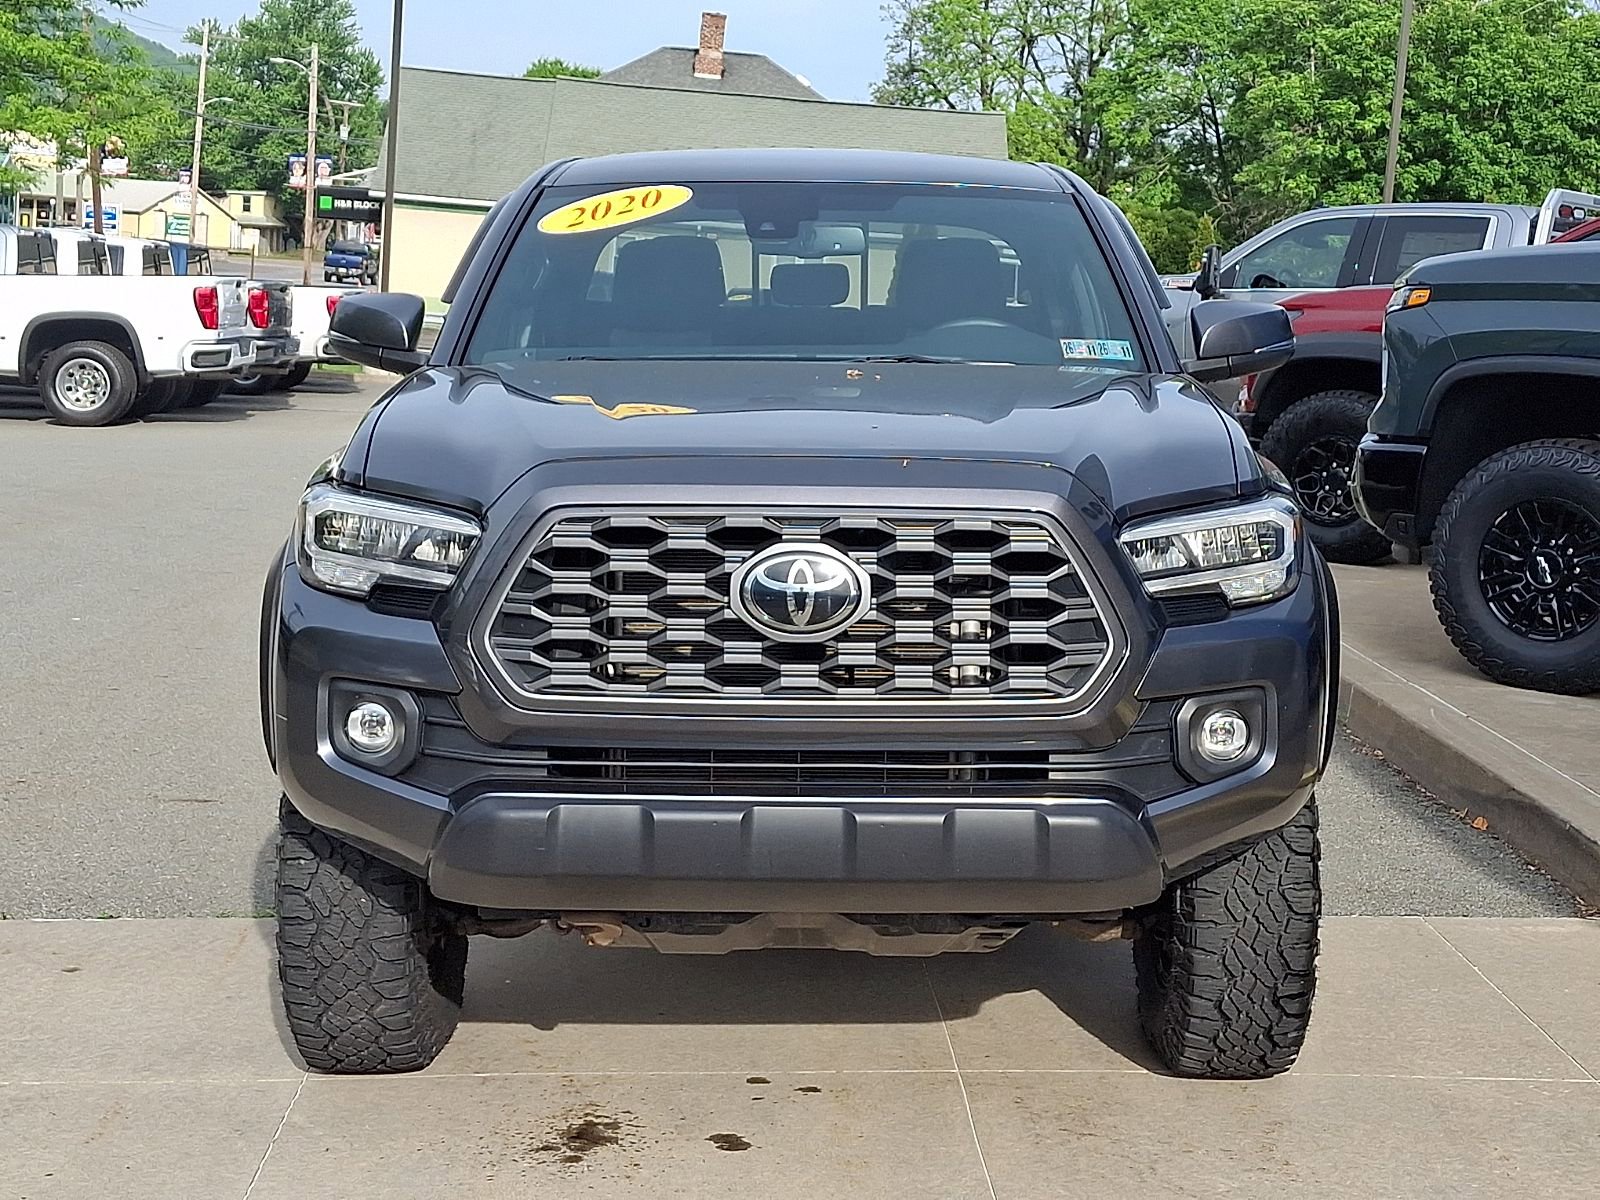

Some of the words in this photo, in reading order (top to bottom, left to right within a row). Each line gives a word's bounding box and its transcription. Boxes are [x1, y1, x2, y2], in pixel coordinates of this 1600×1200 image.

[334, 199, 352, 208] H&R
[353, 200, 380, 209] BLOCK
[566, 189, 662, 228] 2020
